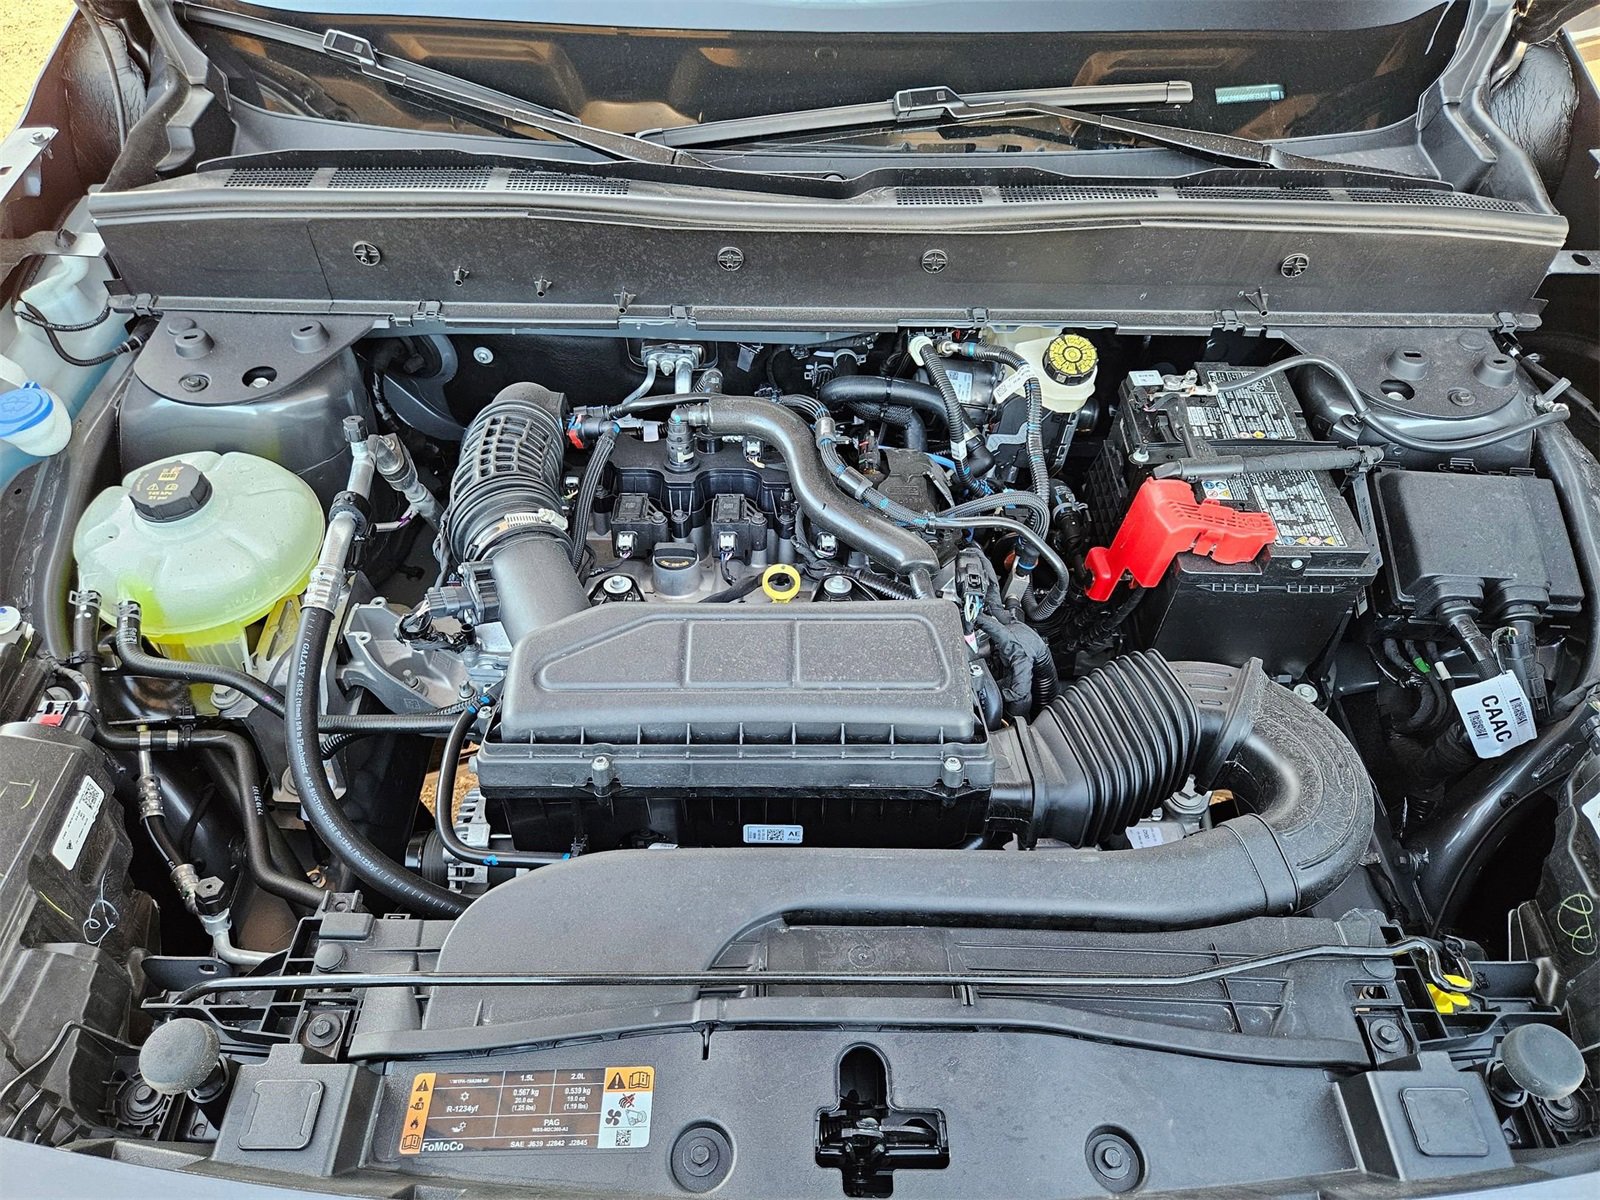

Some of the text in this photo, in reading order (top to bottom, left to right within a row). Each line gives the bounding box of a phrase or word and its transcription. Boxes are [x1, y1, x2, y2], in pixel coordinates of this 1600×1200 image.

[298, 643, 310, 678] GALAXY
[296, 679, 304, 697] 4882
[1482, 695, 1512, 742] CAAC
[304, 776, 314, 788] A/C
[309, 788, 327, 815] SUCTION
[323, 813, 338, 832] HOSE
[531, 1088, 540, 1097] kg
[582, 1088, 591, 1096] kg
[446, 1104, 480, 1113] R-1234yf
[543, 1118, 560, 1126] PAG
[422, 1142, 464, 1152] FoMoCo
